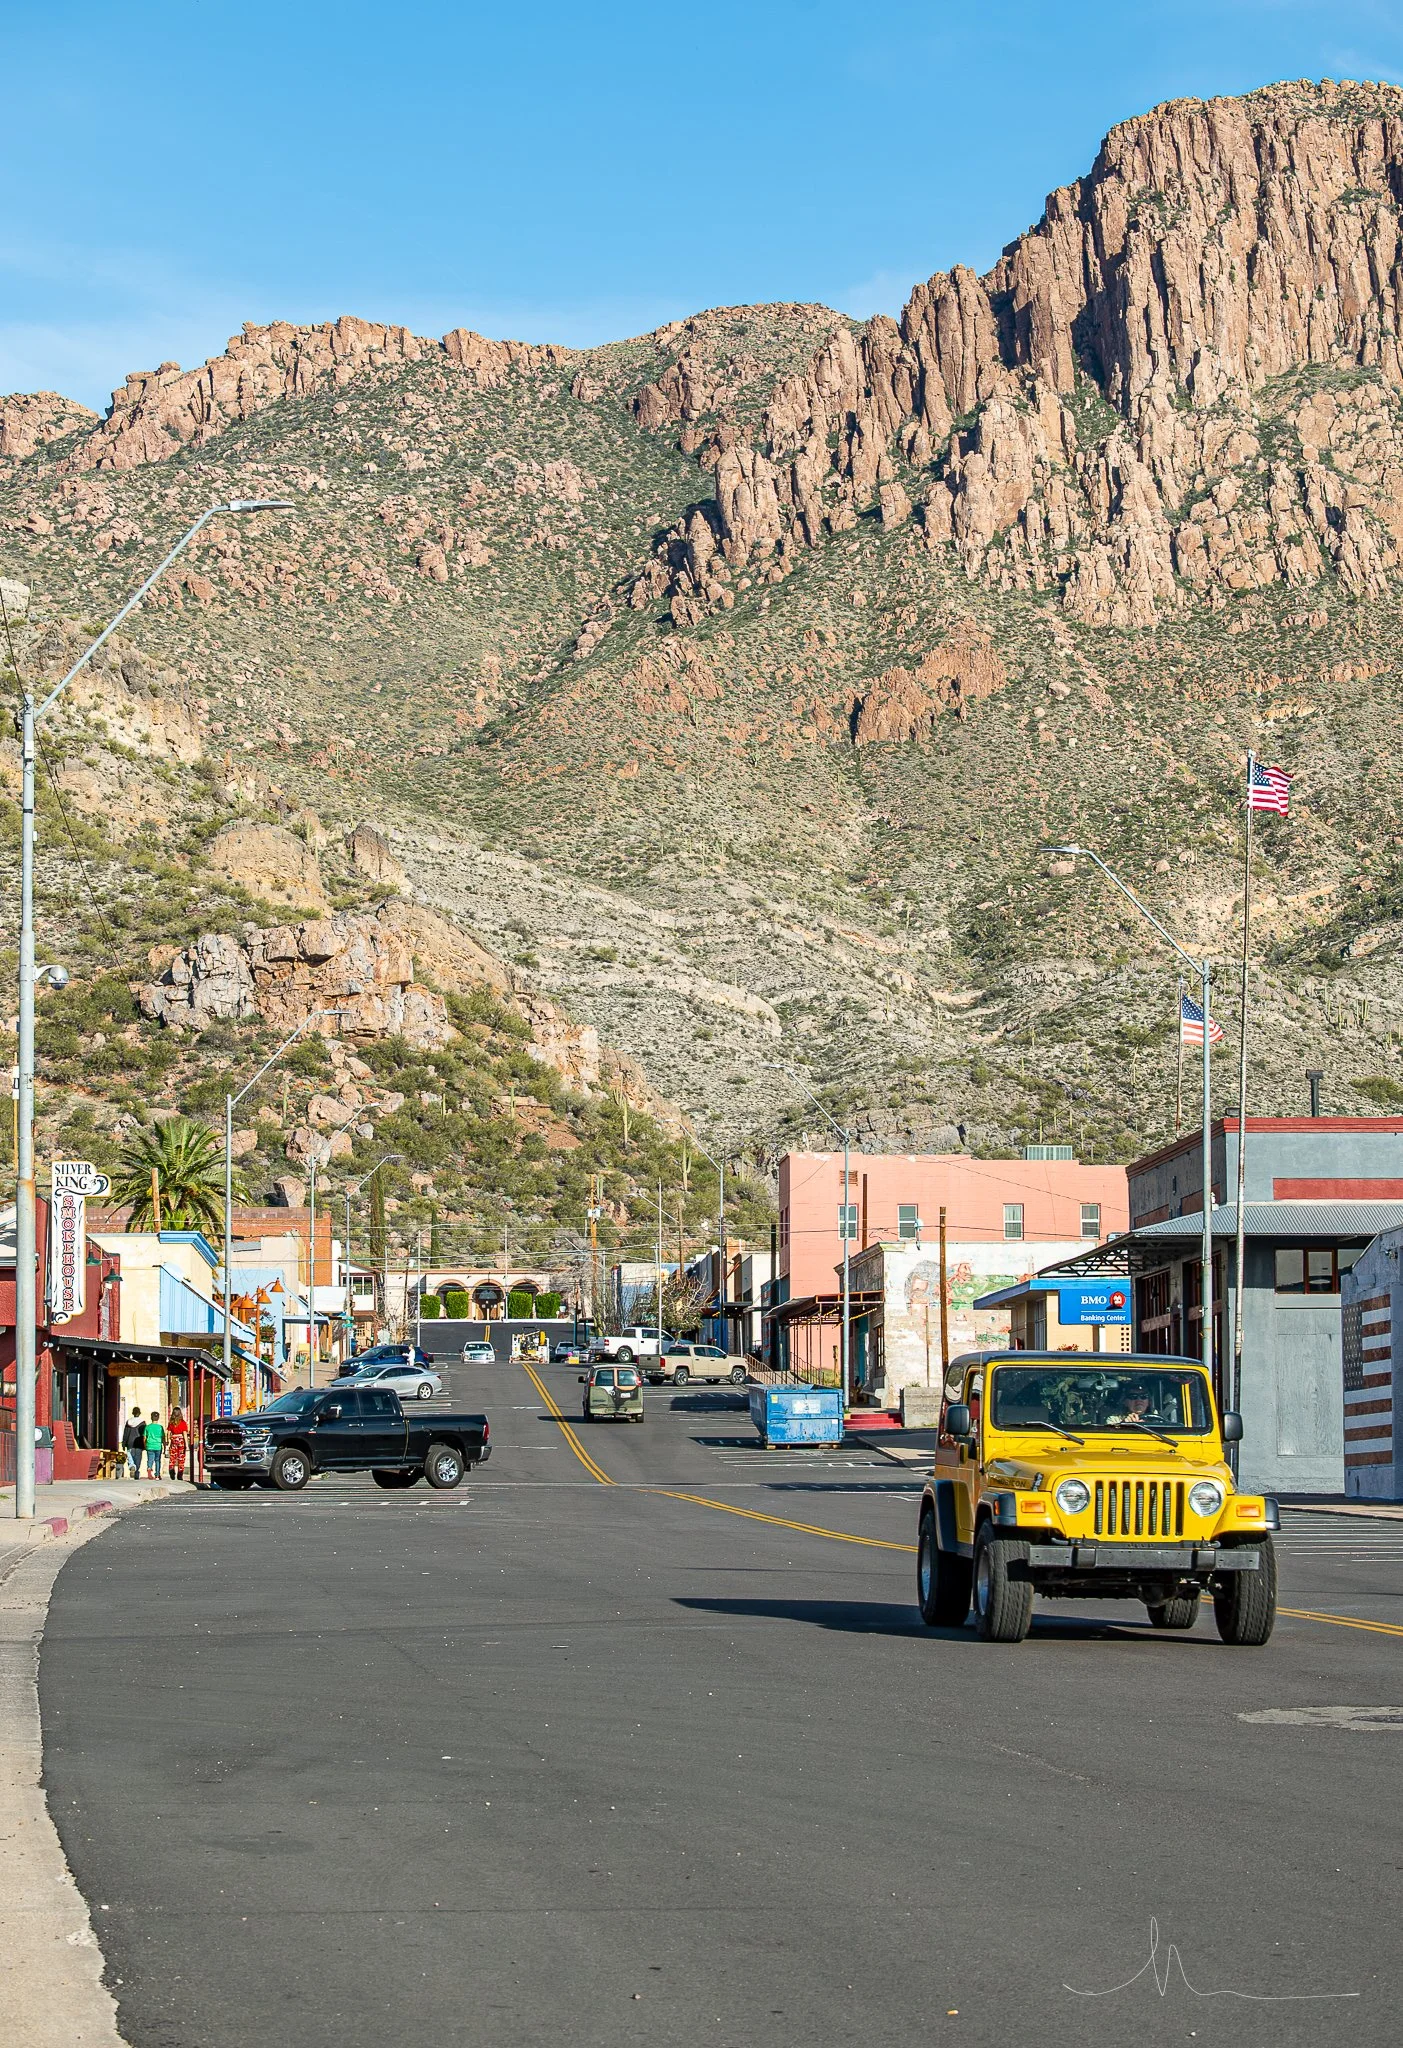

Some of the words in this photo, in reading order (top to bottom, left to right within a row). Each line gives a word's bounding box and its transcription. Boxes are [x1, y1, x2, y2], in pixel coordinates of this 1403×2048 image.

[54, 1163, 92, 1175] SILVER
[56, 1176, 88, 1190] KING
[61, 1195, 76, 1311] SMOKEHOUSE
[1080, 1295, 1107, 1304] BMO
[1080, 1314, 1105, 1322] Banking
